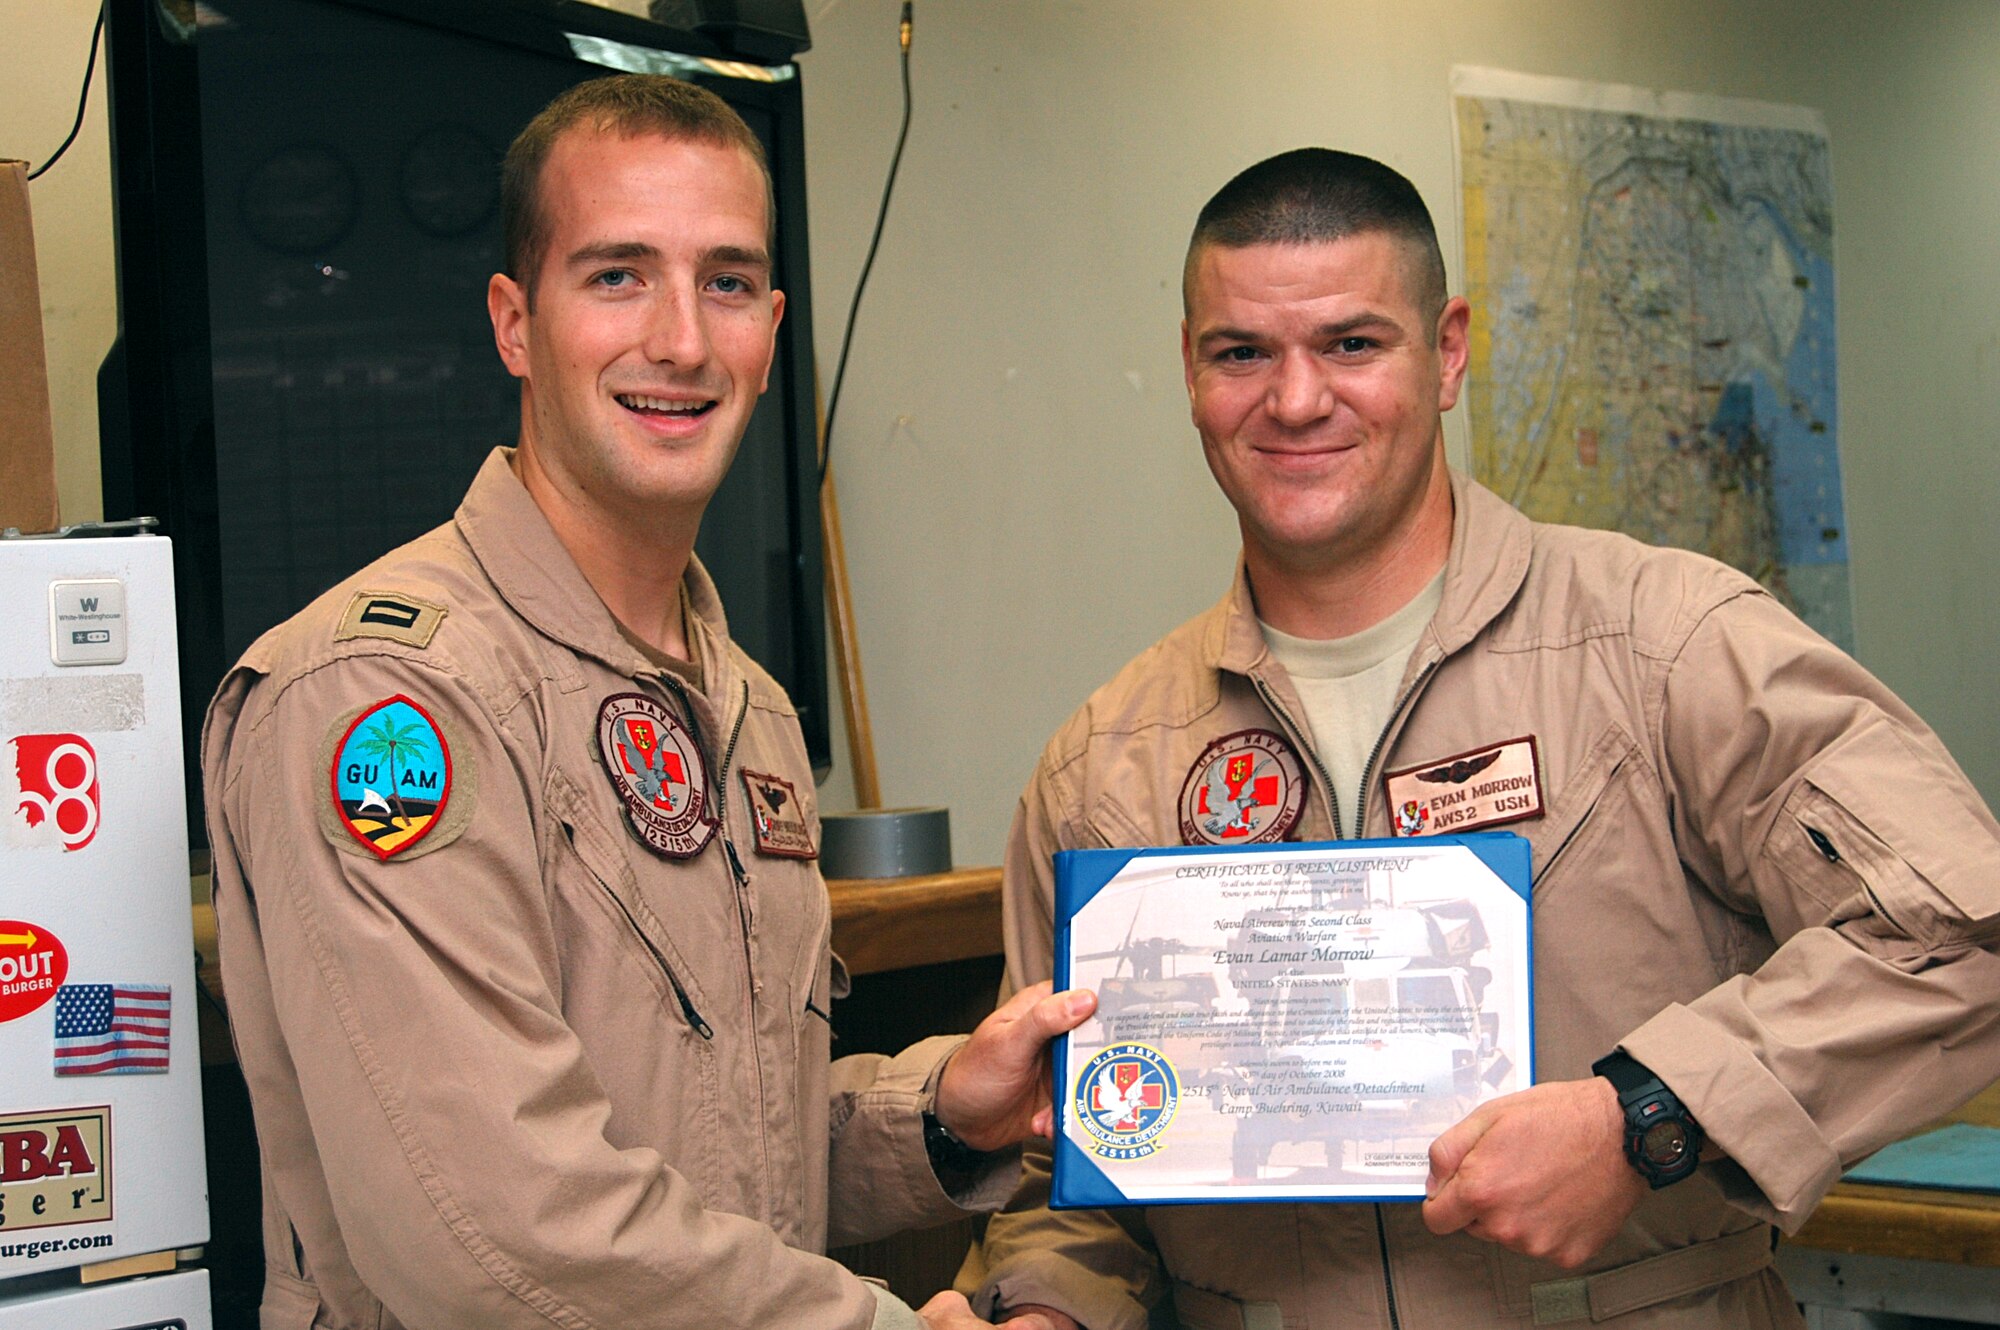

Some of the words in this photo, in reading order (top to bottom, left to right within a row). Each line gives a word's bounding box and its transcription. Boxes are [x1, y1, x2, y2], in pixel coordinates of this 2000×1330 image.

[58, 613, 121, 621] White-Westinghouse
[603, 702, 626, 723] U.S.
[635, 699, 677, 731] NAVY
[1198, 744, 1233, 769] U.S.
[1243, 734, 1287, 756] NAVY
[1472, 775, 1532, 799] MORROW
[614, 774, 629, 794] AIR
[627, 794, 673, 833] AMBULANCE
[671, 787, 702, 833] DETACHMENT
[1433, 807, 1477, 829] AWS2
[1495, 795, 1530, 812] USN
[649, 829, 696, 852] 2515th
[1175, 863, 1270, 879] CERTIFICATE
[1272, 862, 1291, 876] OF
[1295, 858, 1414, 875] REENLISTMENT
[1256, 879, 1272, 887] shall
[1253, 889, 1267, 897] that
[1268, 889, 1278, 898] by
[1213, 919, 1245, 931] Naval
[1308, 914, 1343, 927] Second
[1345, 914, 1372, 926] Class
[1247, 932, 1292, 943] Aviation
[1294, 931, 1337, 946] Warfare
[1212, 950, 1253, 964] Evan
[1257, 949, 1307, 964] Lamar
[1311, 945, 1375, 962] Morrow
[1290, 968, 1305, 976] the
[3, 978, 53, 996] BURGER
[1232, 979, 1274, 989] UNITED
[1277, 978, 1319, 988] STATES
[1322, 977, 1352, 988] NAVY
[1364, 1006, 1388, 1014] United
[1366, 1016, 1379, 1024] and
[1163, 1031, 1175, 1039] the
[1176, 1030, 1206, 1041] Uniform
[1206, 1030, 1223, 1039] Code
[1224, 1030, 1233, 1040] of
[1388, 1025, 1398, 1034] all
[1337, 1037, 1351, 1045] and
[1093, 1050, 1120, 1066] U.S.
[1126, 1046, 1162, 1063] NAVY
[1333, 1058, 1347, 1066] this
[1261, 1069, 1277, 1081] day
[1277, 1069, 1288, 1082] of
[1289, 1068, 1321, 1079] October
[1323, 1069, 1346, 1079] 2008
[1182, 1083, 1220, 1097] 2515th
[1222, 1083, 1260, 1099] Naval
[1261, 1084, 1282, 1096] Air
[1284, 1081, 1351, 1095] Ambulance
[1352, 1081, 1425, 1094] Detachment
[1219, 1103, 1253, 1118] Camp
[1255, 1100, 1312, 1117] Buehring,
[1315, 1100, 1362, 1113] Kuwait
[1075, 1098, 1086, 1114] AIR
[1082, 1116, 1132, 1145] AMBULANCE
[1135, 1096, 1177, 1143] DETACHMENT
[1099, 1145, 1152, 1159] 2515th
